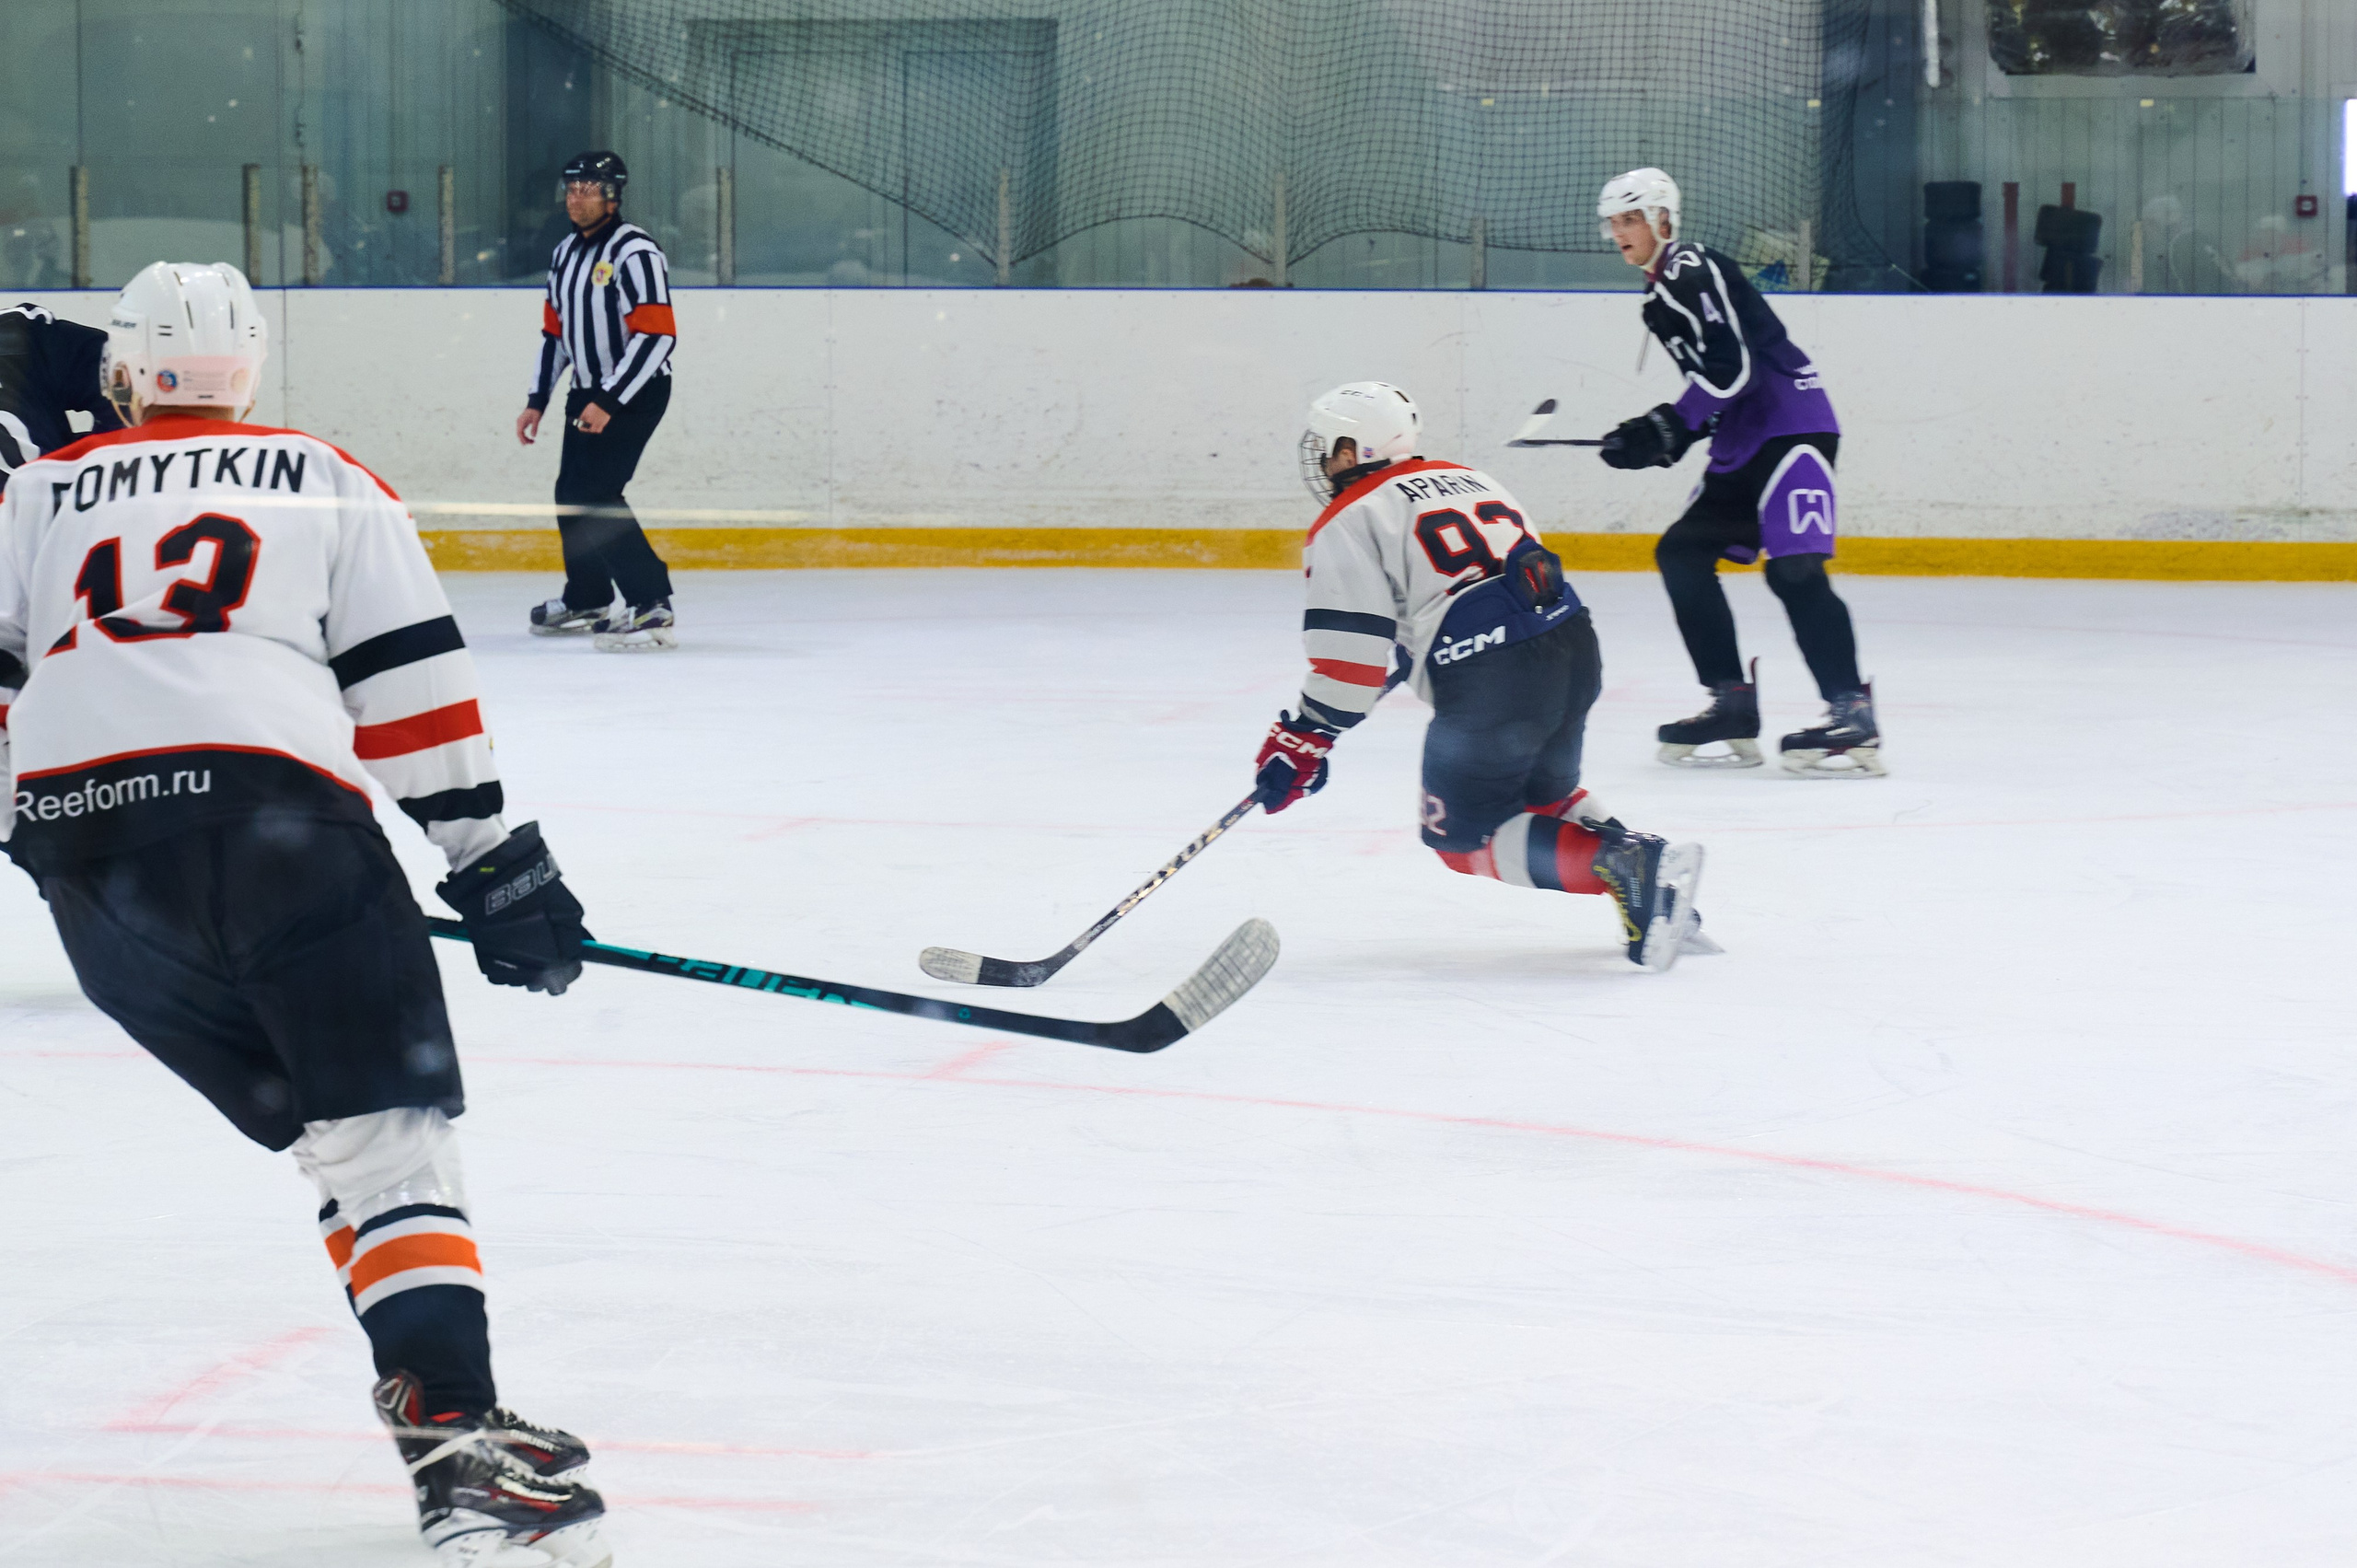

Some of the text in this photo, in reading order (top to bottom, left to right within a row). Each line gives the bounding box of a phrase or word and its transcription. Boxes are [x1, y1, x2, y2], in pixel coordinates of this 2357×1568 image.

[1394, 474, 1492, 504] APARIN
[1414, 500, 1538, 595] 92
[43, 512, 262, 657] 13
[1433, 625, 1506, 666] CCM
[14, 770, 211, 822] Reeform.ru
